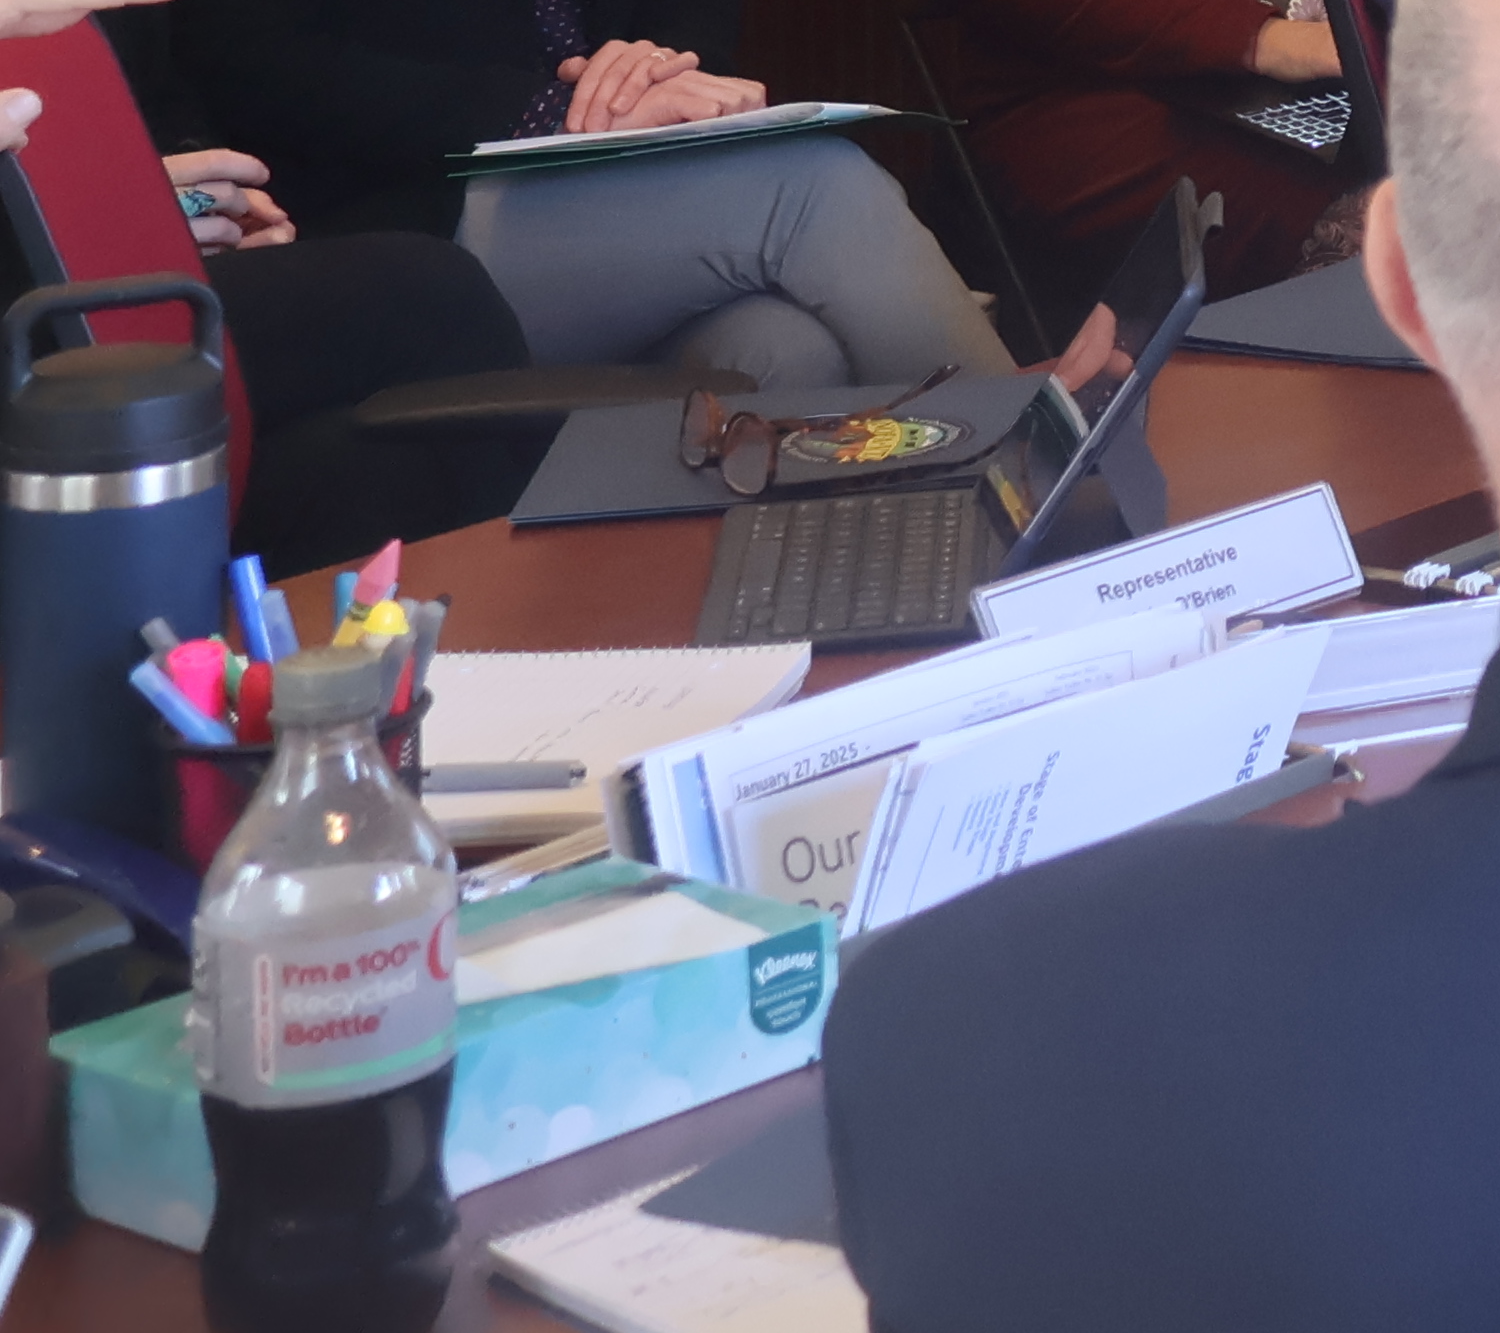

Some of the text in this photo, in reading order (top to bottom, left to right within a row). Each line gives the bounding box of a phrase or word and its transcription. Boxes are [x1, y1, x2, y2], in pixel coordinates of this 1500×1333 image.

[1097, 546, 1238, 603] Representative
[736, 742, 859, 801] January 27, 2025
[783, 830, 860, 883] Our
[283, 1013, 382, 1046] Bottle
